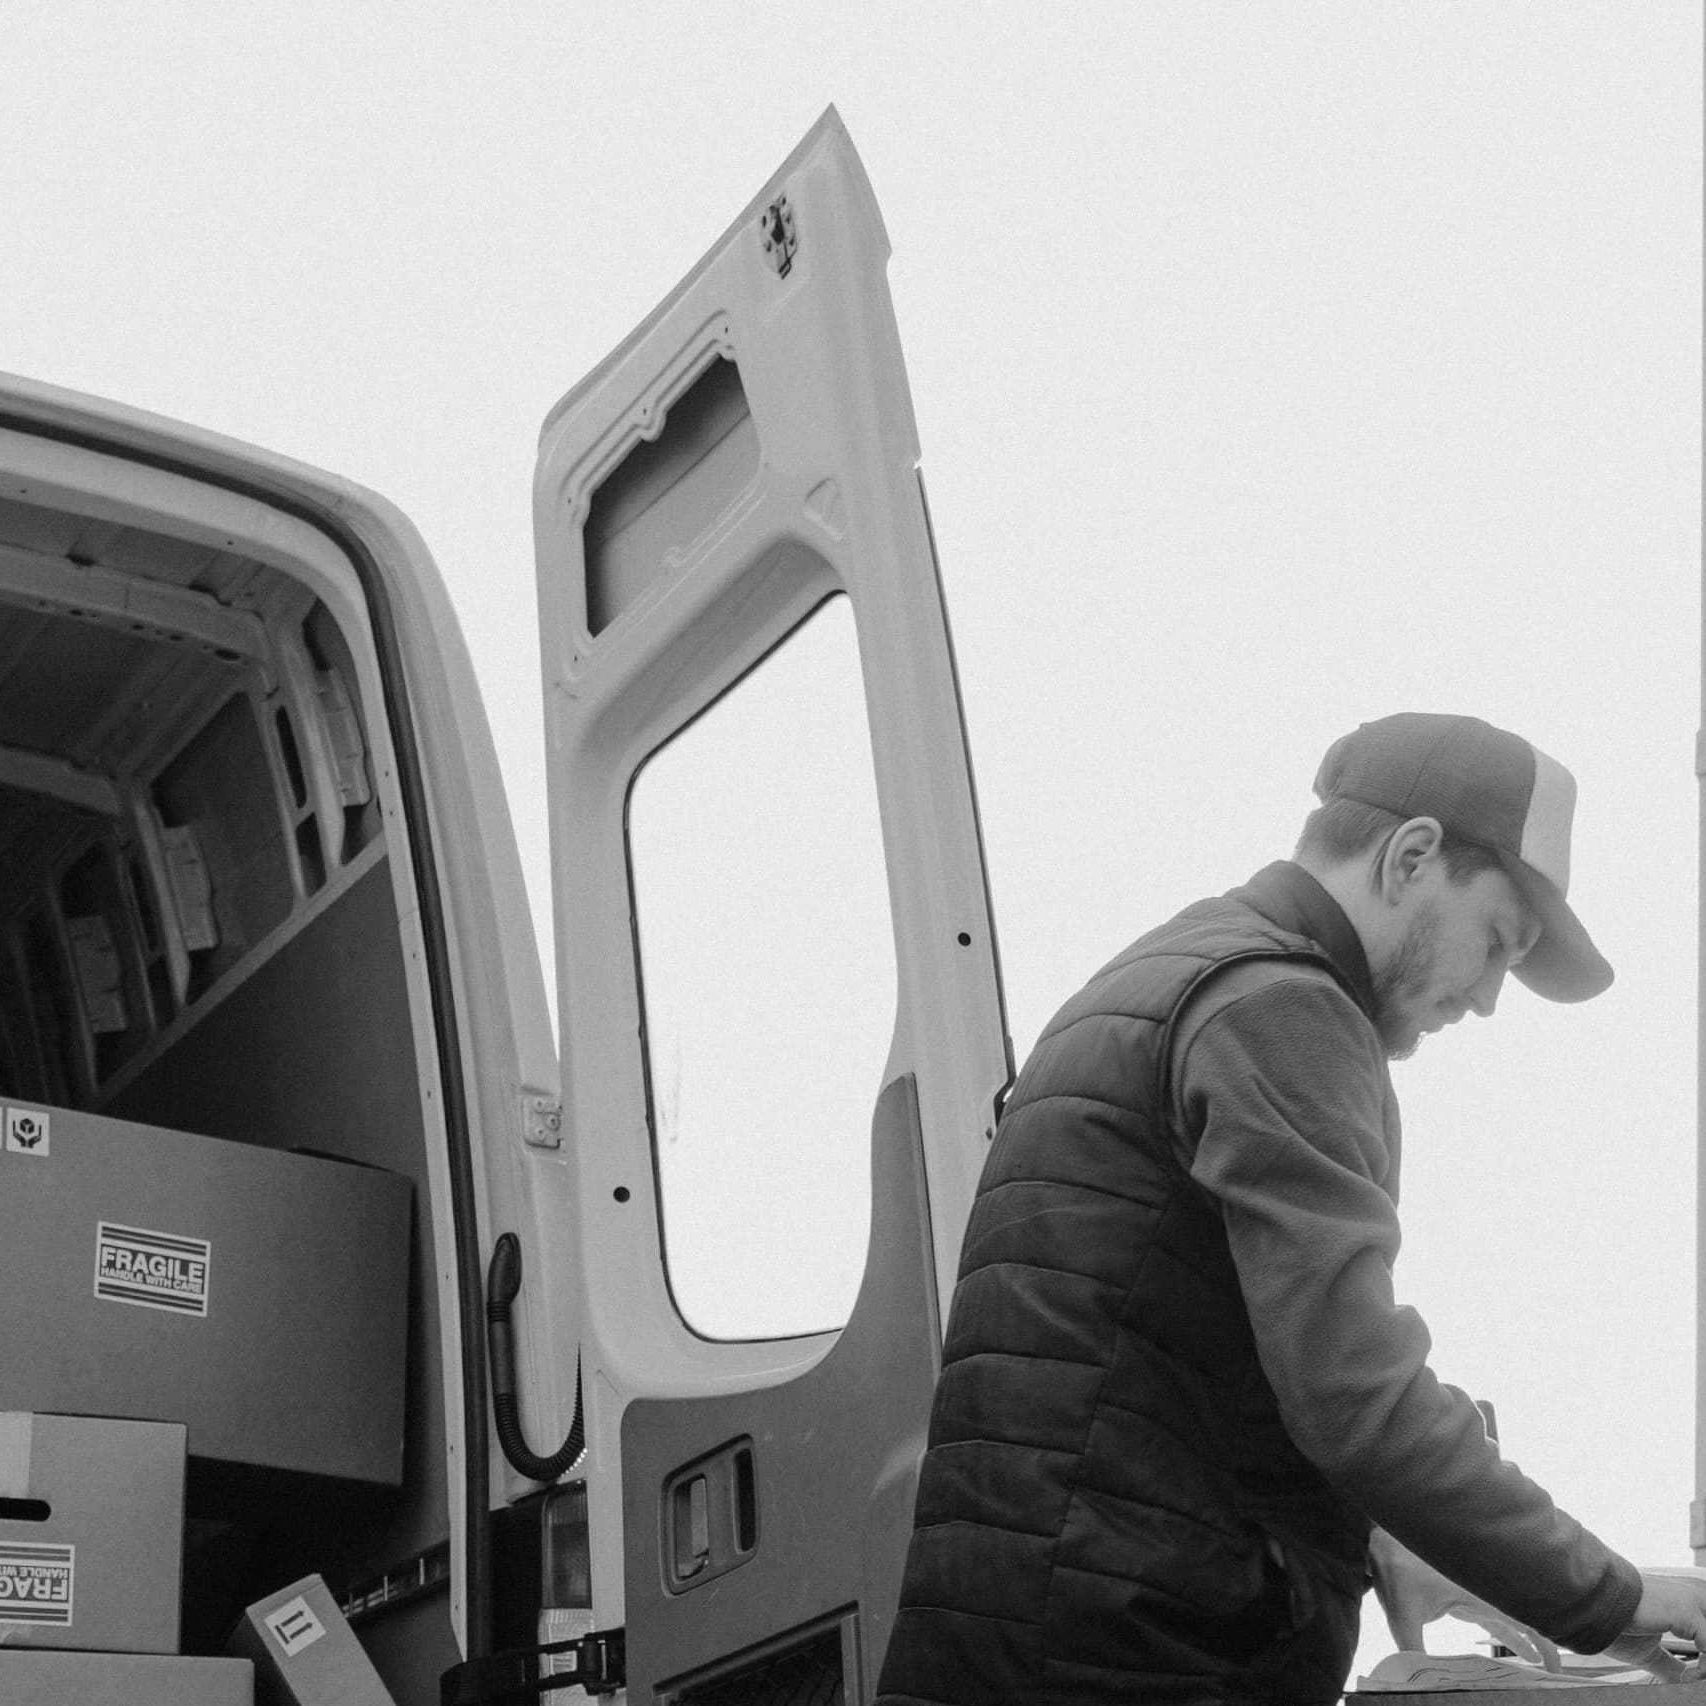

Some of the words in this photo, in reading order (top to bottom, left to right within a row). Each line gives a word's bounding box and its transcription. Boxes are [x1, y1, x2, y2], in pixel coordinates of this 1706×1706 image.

[102, 1246, 204, 1283] FRAGILE
[101, 1267, 143, 1283] HANDLE
[145, 1275, 172, 1288] WITH
[173, 1280, 202, 1294] CARE
[19, 1567, 68, 1579] HANDLE
